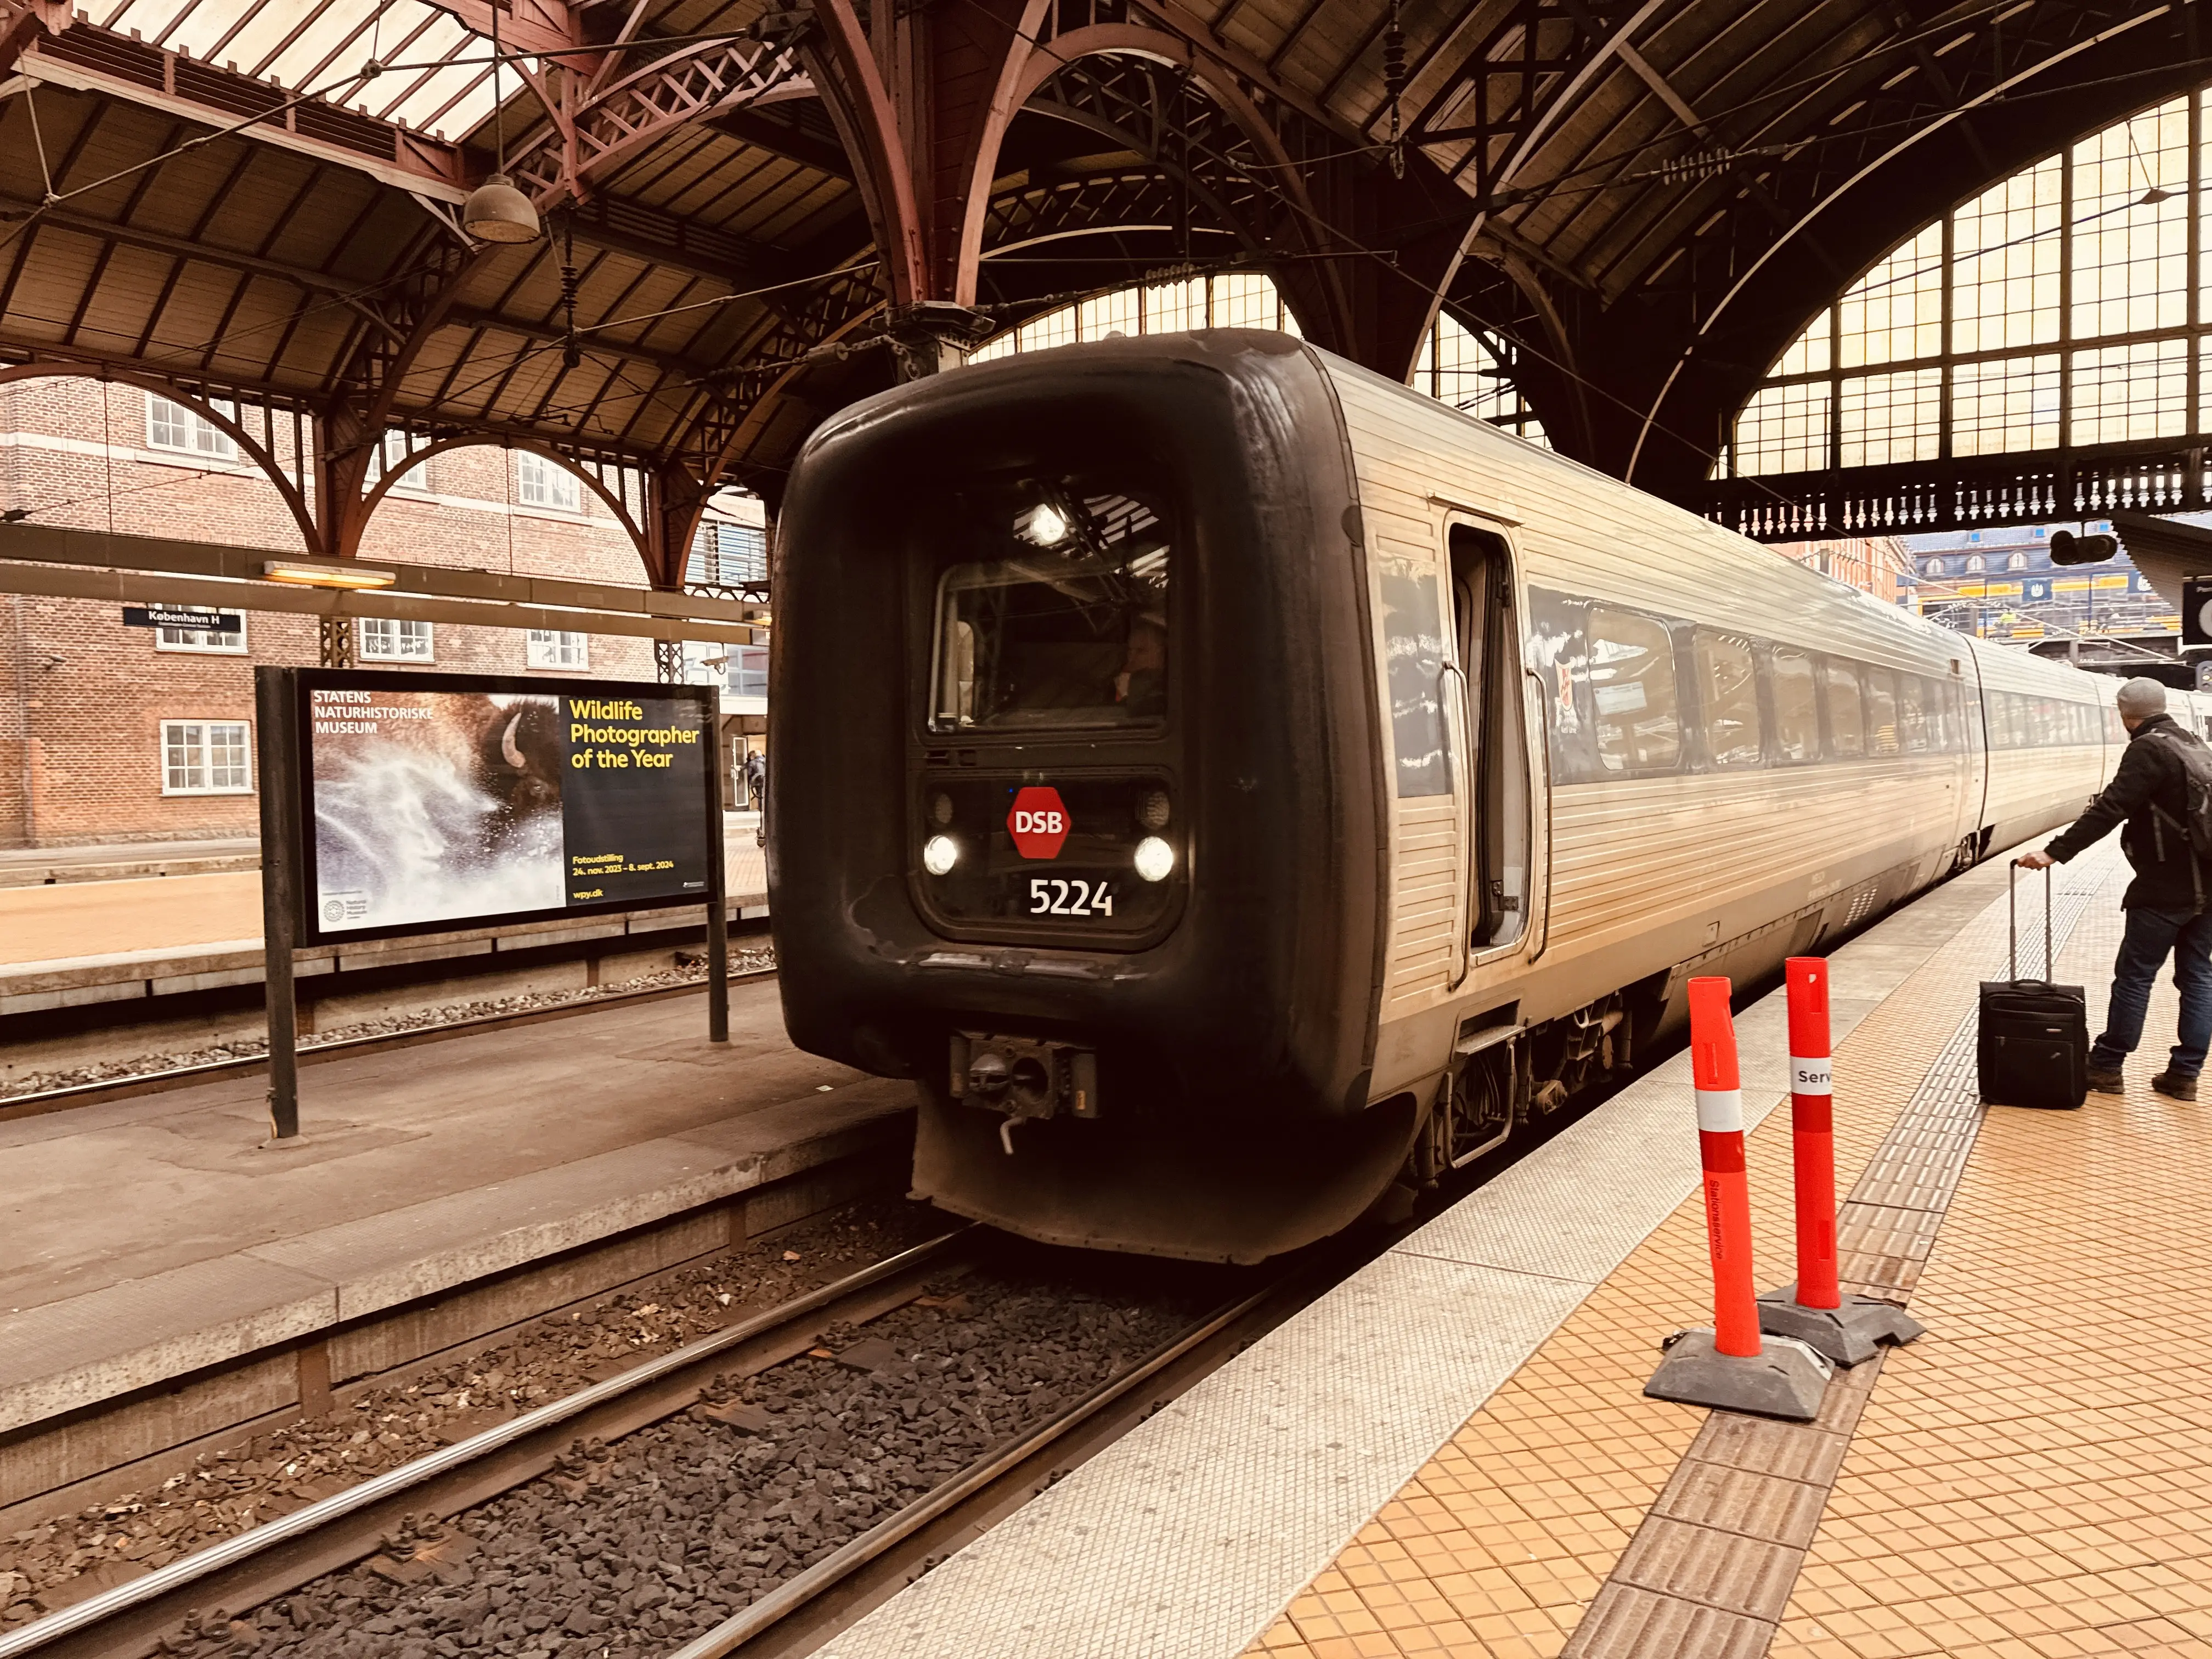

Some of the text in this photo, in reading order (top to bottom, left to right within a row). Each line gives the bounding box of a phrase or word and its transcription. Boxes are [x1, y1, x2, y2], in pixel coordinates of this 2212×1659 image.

[148, 611, 220, 624] København H
[313, 691, 371, 703] STATENS
[315, 706, 433, 719] NATURHISTORISKE
[569, 699, 643, 720] Wildlife
[315, 721, 377, 733] MUSEUM
[571, 724, 700, 747] Photographer
[572, 748, 674, 768] of the Year
[1015, 811, 1063, 834] DSB
[572, 854, 624, 865] Fotoudstng
[572, 867, 586, 876] 24.
[605, 865, 622, 873] 2023
[629, 864, 636, 872] 8.
[637, 862, 655, 872] sept.
[656, 861, 674, 869] 2024
[573, 889, 603, 899] wpy.dk
[1030, 879, 1113, 916] 5224
[1798, 1070, 1831, 1083] Serv
[1709, 1180, 1726, 1260] Stationsservice
